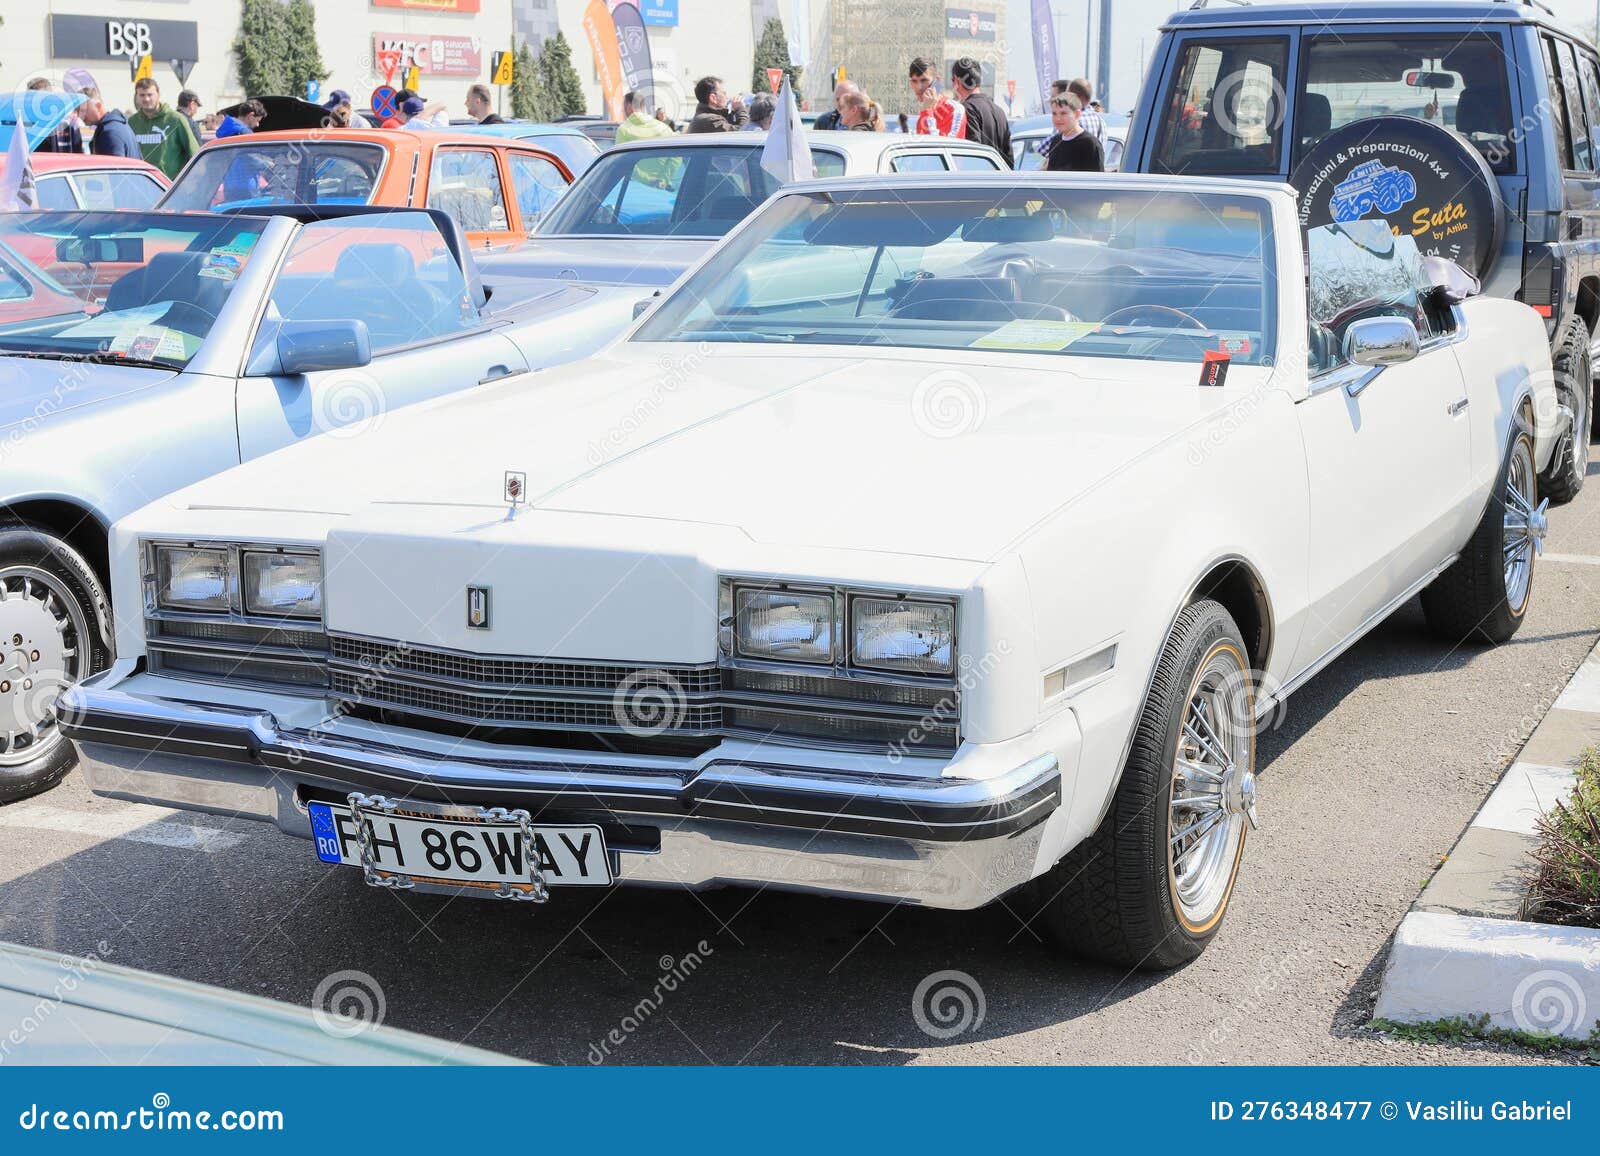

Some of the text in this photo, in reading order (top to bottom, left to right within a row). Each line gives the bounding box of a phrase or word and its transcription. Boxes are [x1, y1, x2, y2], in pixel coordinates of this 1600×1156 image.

[108, 21, 153, 56] BSB
[503, 62, 509, 80] 6
[1299, 142, 1449, 226] Riparazioni & Preparazioni 4x4
[1412, 203, 1467, 236] Suta
[1432, 231, 1444, 240] by
[318, 836, 339, 857] RO
[420, 827, 592, 876] 86WAY
